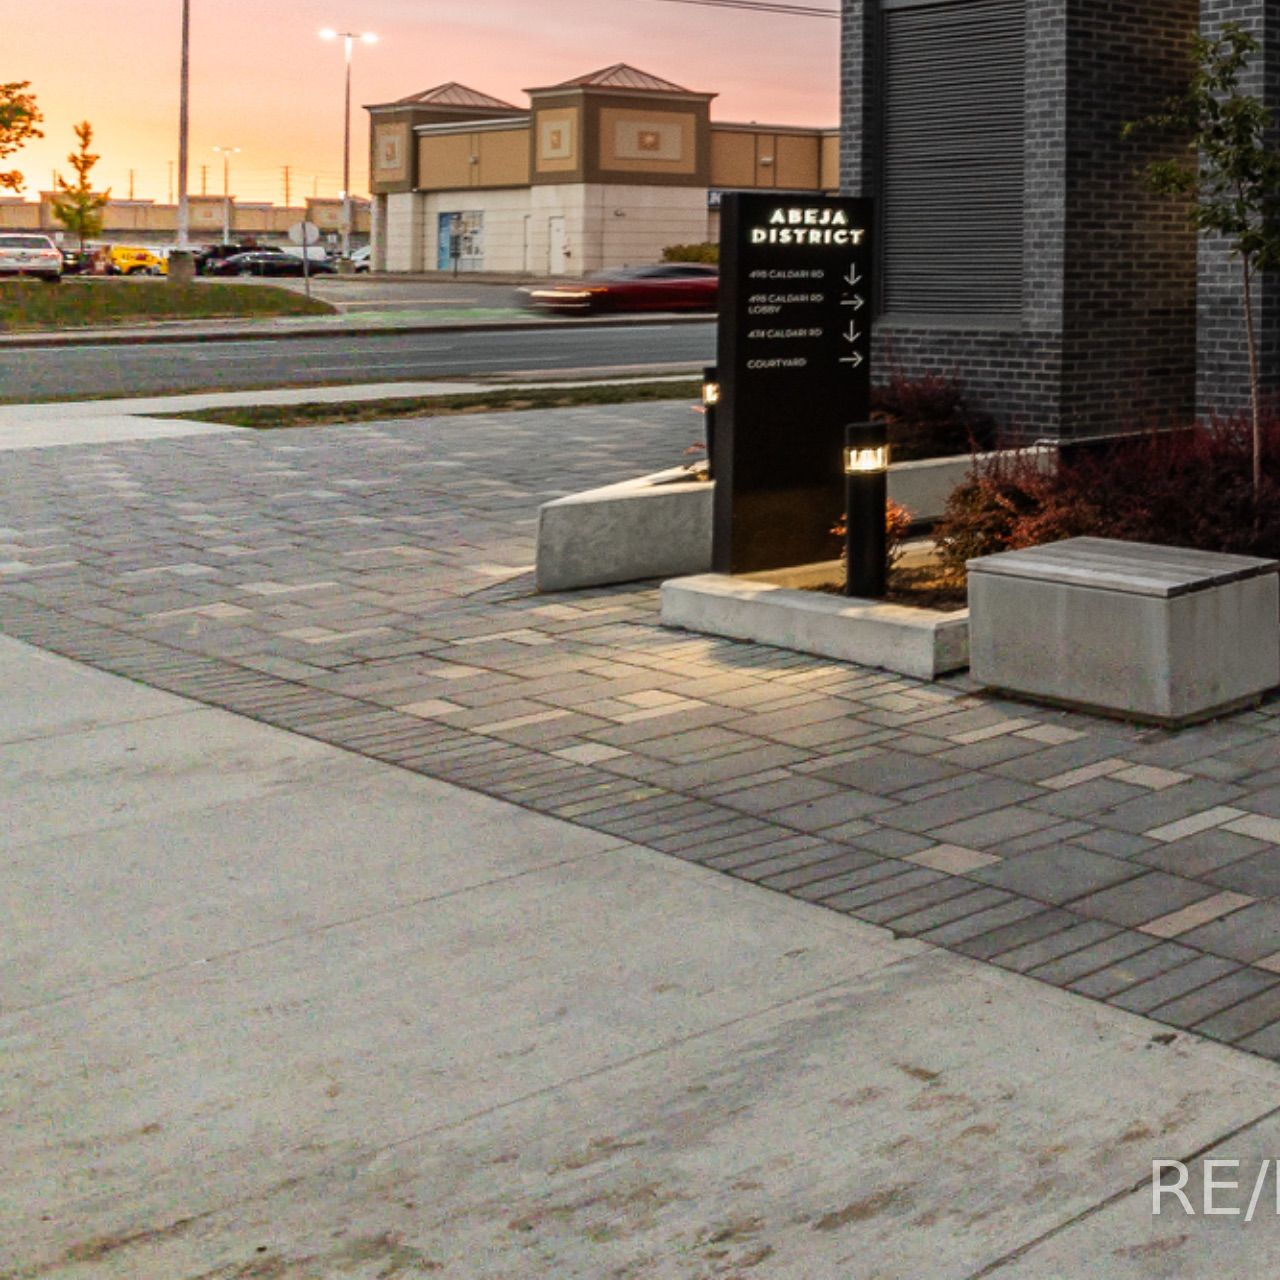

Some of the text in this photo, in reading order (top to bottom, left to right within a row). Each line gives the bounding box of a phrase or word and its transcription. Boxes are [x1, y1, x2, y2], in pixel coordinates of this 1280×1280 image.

[769, 208, 848, 225] ABEJA
[751, 228, 865, 244] DISTRICT
[769, 269, 809, 279] CALDARI
[810, 269, 824, 278] RD
[768, 294, 809, 303] CALDARI
[810, 293, 824, 303] RD
[747, 305, 782, 315] LOBBY
[767, 328, 807, 338] CALDARI
[808, 327, 823, 337] RD
[746, 358, 807, 369] COURTYARD
